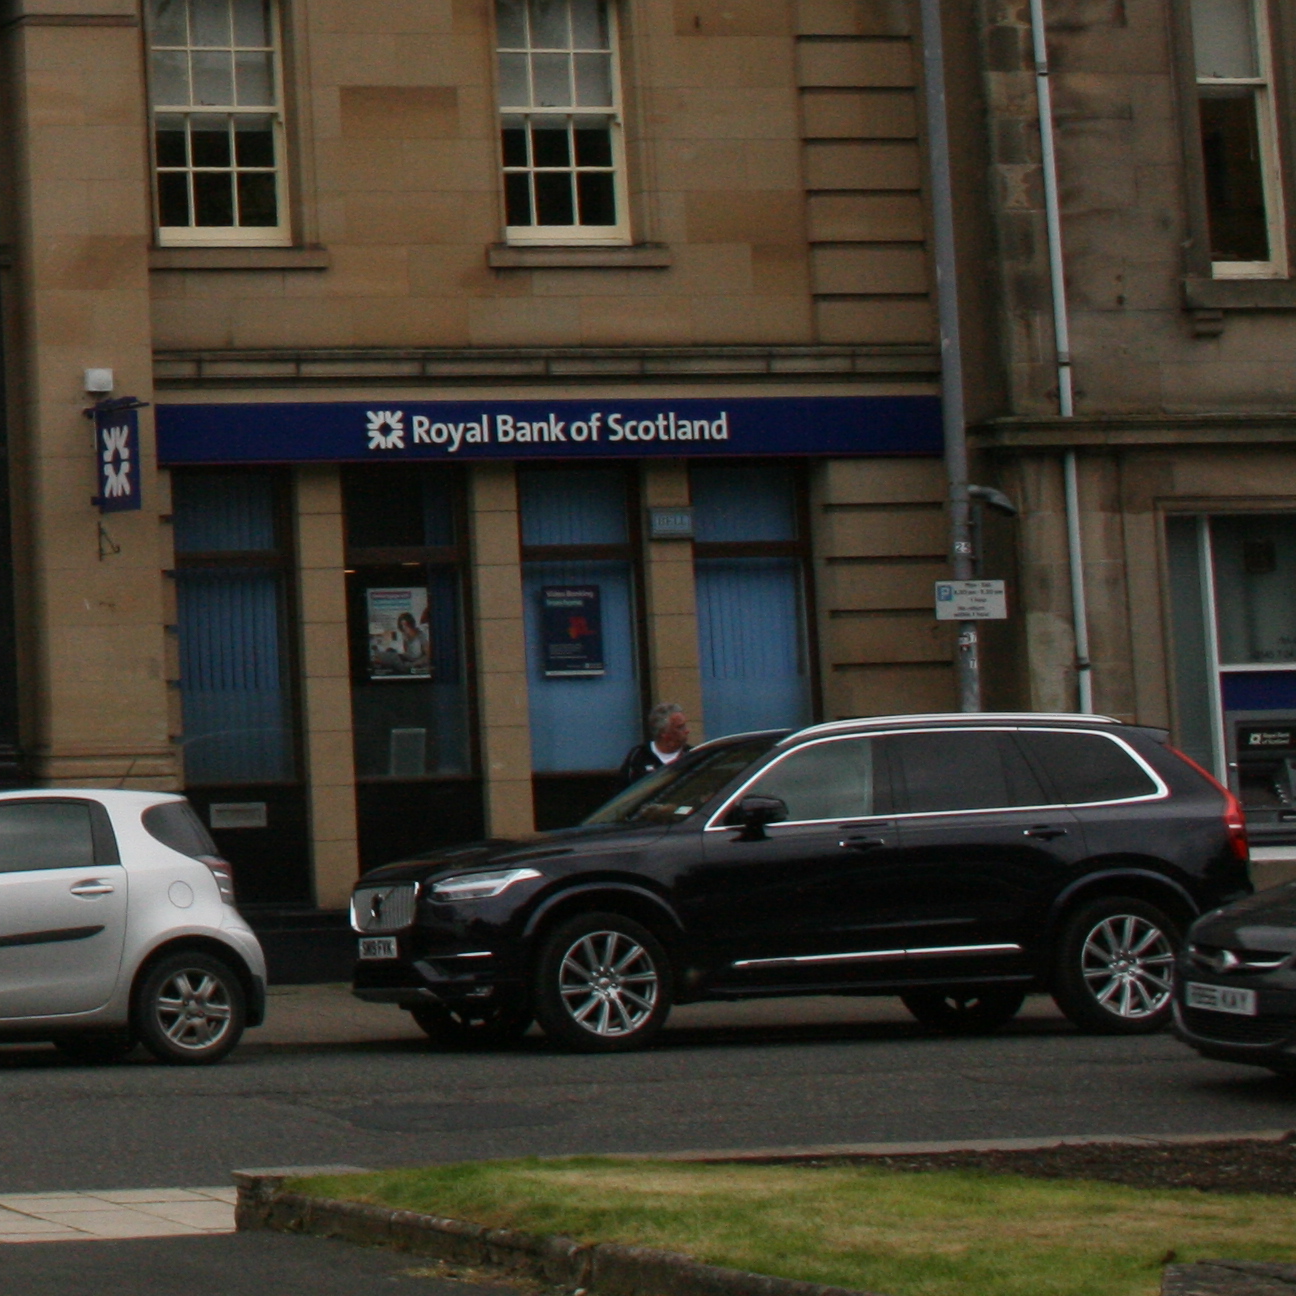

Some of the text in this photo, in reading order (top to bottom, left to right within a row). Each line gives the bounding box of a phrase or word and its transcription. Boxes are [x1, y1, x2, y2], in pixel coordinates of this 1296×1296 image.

[412, 411, 729, 452] Royal Bank of Scotland
